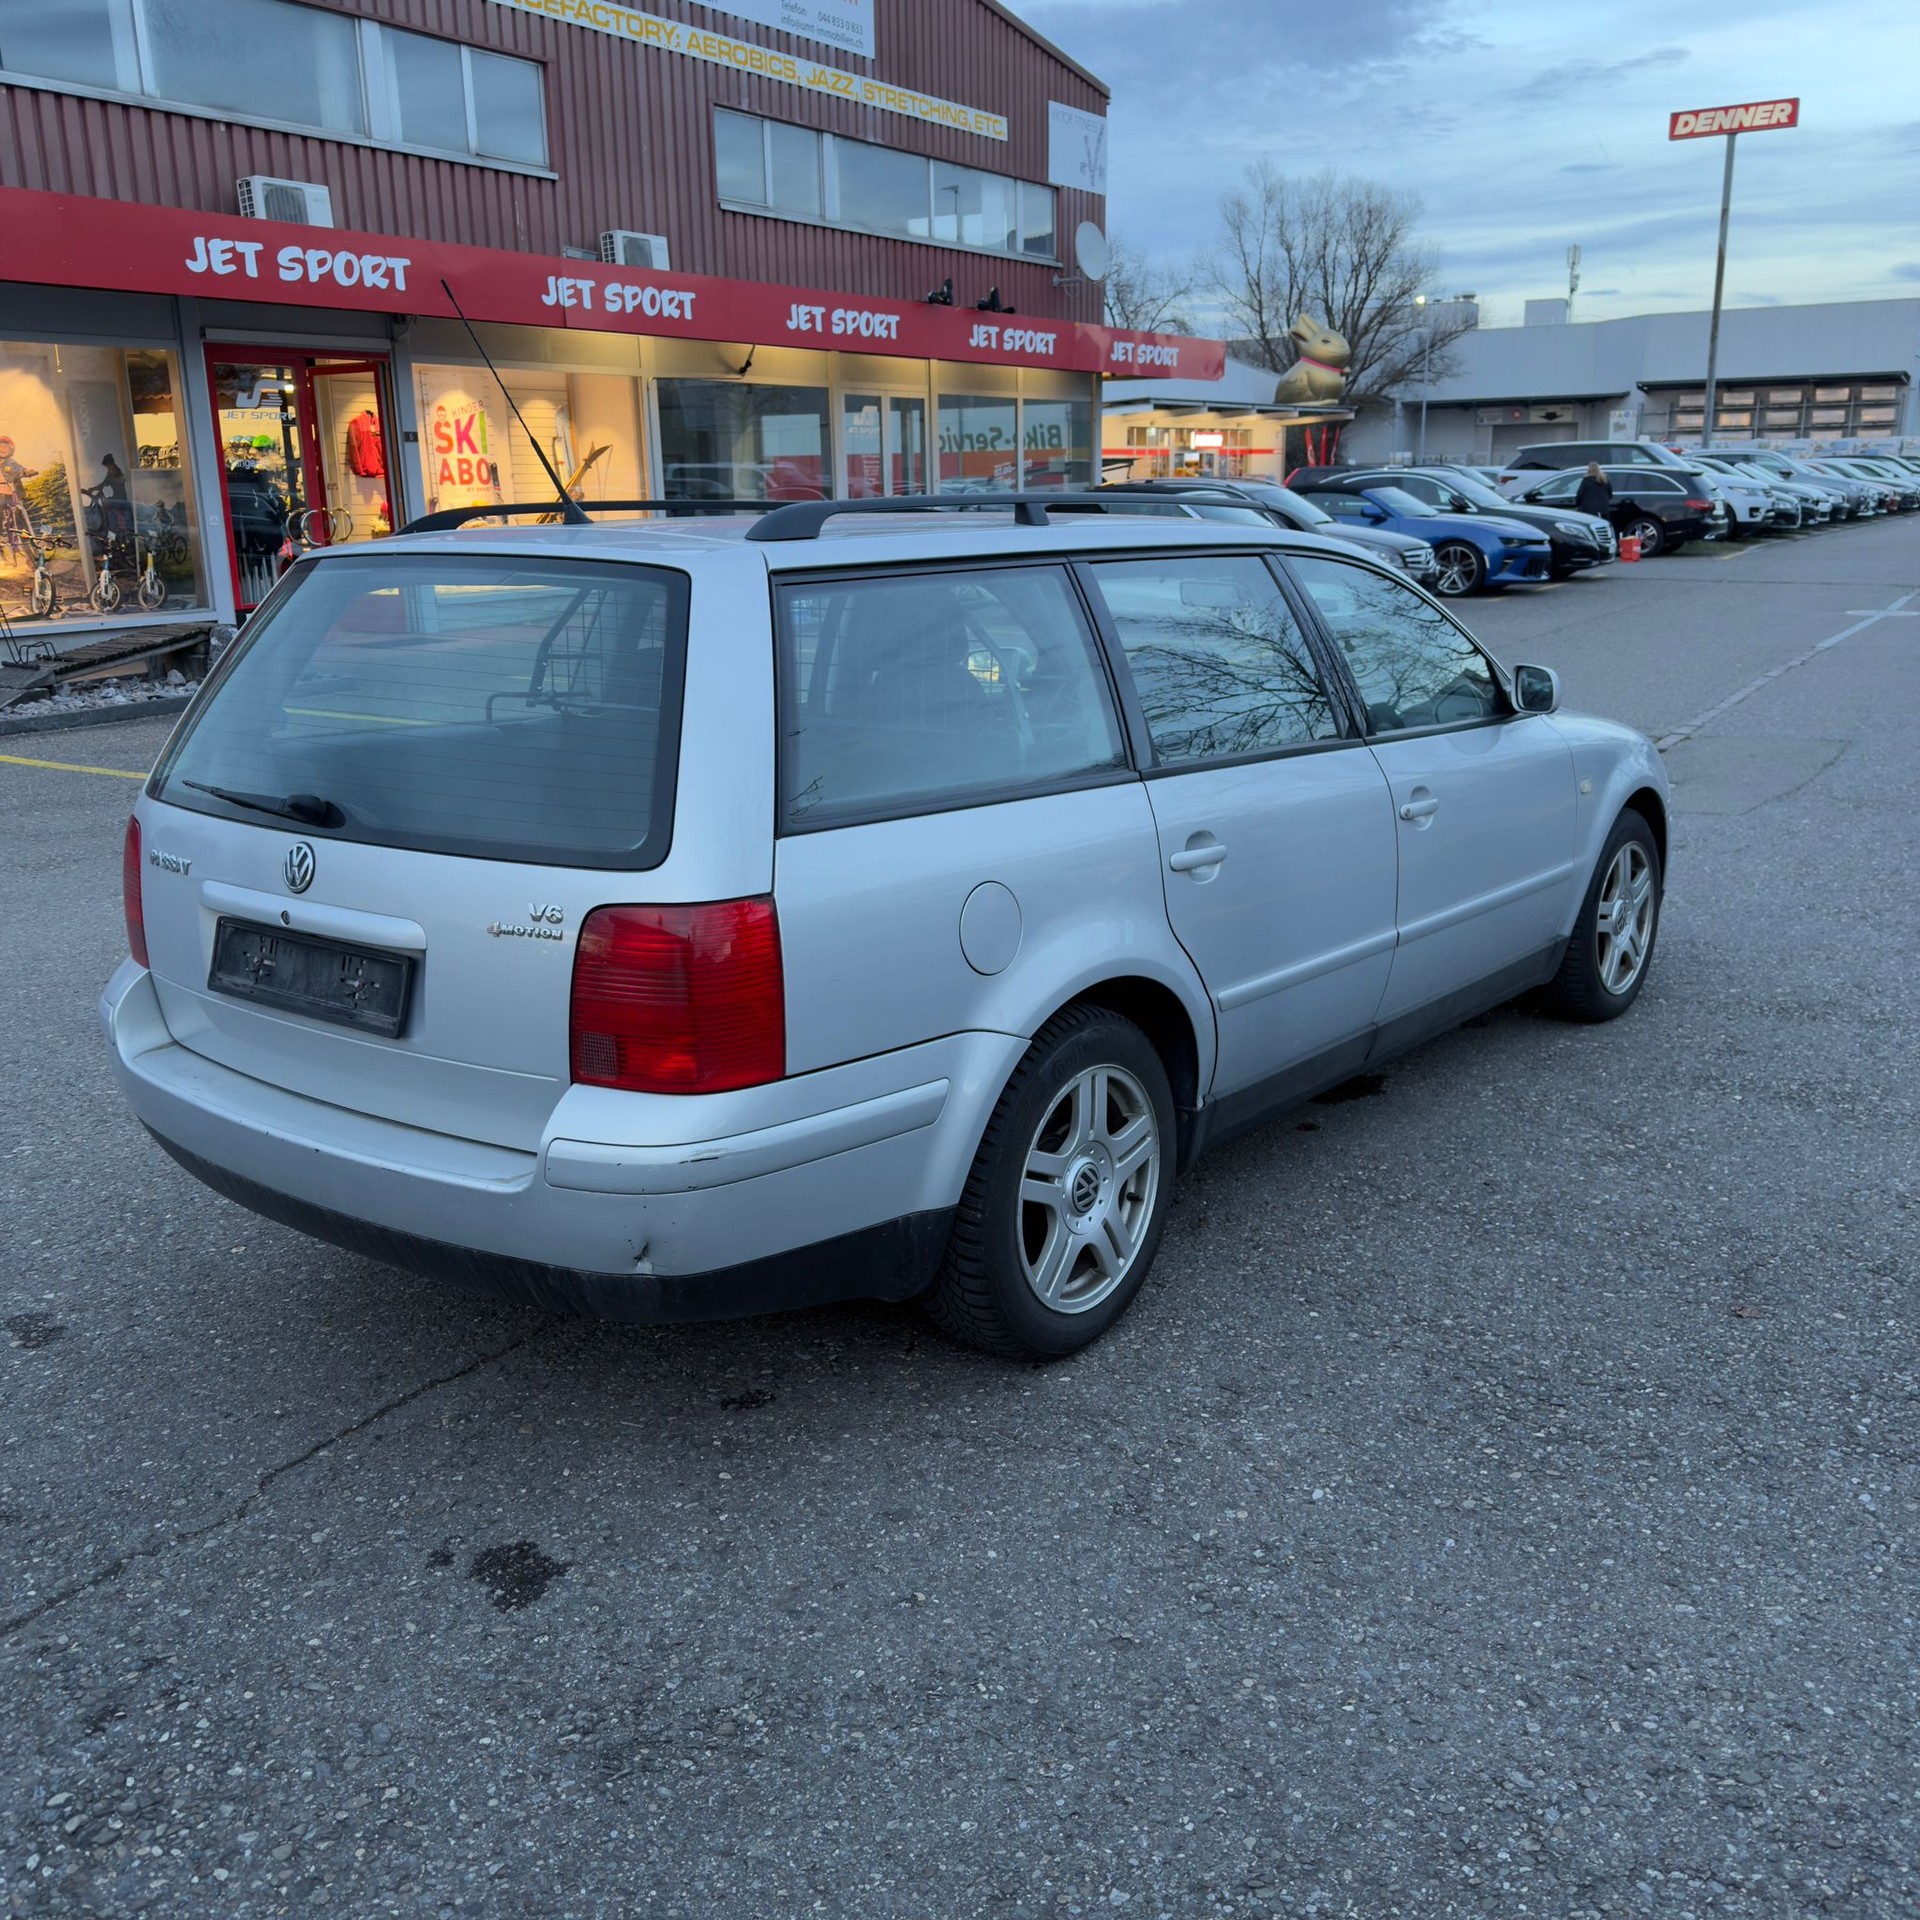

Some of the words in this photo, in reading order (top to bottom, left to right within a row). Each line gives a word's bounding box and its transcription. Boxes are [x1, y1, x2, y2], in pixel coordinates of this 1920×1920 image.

[781, 0, 807, 17] Telefon
[818, 11, 831, 24] 044
[806, 67, 858, 101] JAZZ,
[864, 82, 971, 132] STRETCHING,
[975, 114, 1005, 137] ETC.
[1674, 102, 1793, 136] DENNER
[186, 237, 263, 277] JET
[277, 246, 411, 291] SPORT
[542, 276, 595, 309] JET
[604, 283, 695, 320] SPORT
[786, 304, 825, 332] JET
[832, 309, 900, 340] SPORT
[969, 325, 998, 350] JET
[1003, 328, 1057, 355] SPORT
[1110, 341, 1134, 364] JET
[1138, 344, 1179, 367] SPORT
[224, 411, 247, 419] JET
[250, 411, 292, 421] SPORT
[452, 400, 485, 417] KINDER
[434, 410, 488, 454] SKI
[439, 458, 491, 486] ABO
[150, 849, 192, 876] PASSAT
[528, 902, 563, 924] V6
[486, 920, 563, 941] 4MOTION
